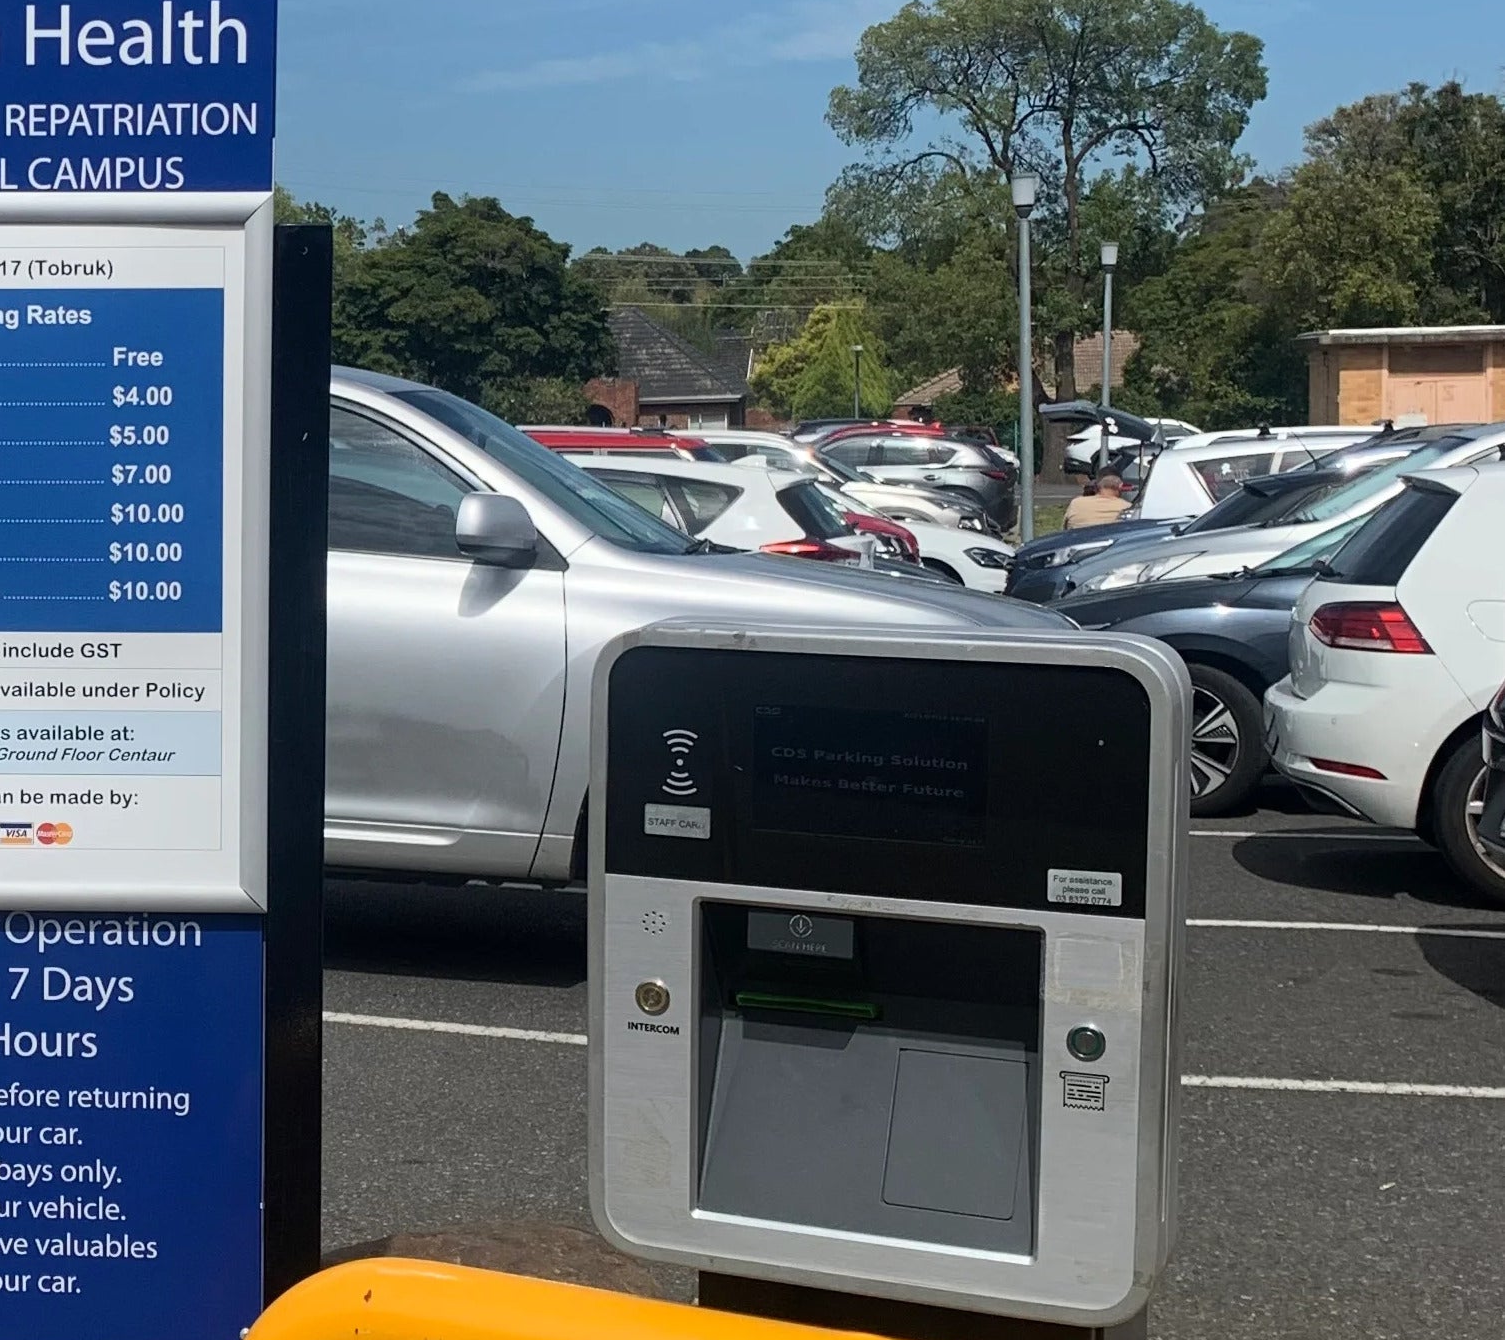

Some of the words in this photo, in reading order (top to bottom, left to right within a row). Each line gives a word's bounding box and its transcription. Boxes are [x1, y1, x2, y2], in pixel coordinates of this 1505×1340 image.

[26, 0, 246, 65] Health
[6, 103, 256, 136] REPATRIATION
[28, 157, 184, 189] CAMPUS
[29, 260, 112, 279] (Tobruk)
[28, 305, 91, 324] Rates
[114, 347, 163, 366] Free
[113, 386, 172, 407] $4.00
[110, 425, 169, 447] $5.00
[112, 464, 171, 485] $7.00
[111, 503, 183, 524] $10.00
[110, 542, 182, 563] $10.00
[109, 581, 181, 602] $10.00
[4, 643, 74, 658] include
[81, 643, 122, 658] GST
[83, 683, 139, 697] under
[147, 683, 205, 702] Policy
[17, 725, 104, 740] available
[111, 726, 134, 740] at:
[61, 748, 105, 760] Floor
[109, 748, 175, 761] Centaur
[21, 789, 43, 804] be
[51, 790, 103, 804] made
[111, 790, 137, 808] by:
[648, 818, 676, 826] STAFF
[6, 829, 27, 838] VISA
[5, 911, 201, 952] Operation
[9, 968, 29, 999] 7
[44, 967, 133, 1011] Days
[627, 1021, 680, 1035] INTERCOM
[69, 1087, 189, 1116] returning
[40, 1127, 82, 1145] car.
[61, 1159, 121, 1189] only.
[29, 1195, 125, 1220] vehicle.
[35, 1233, 157, 1258] valuables
[38, 1276, 80, 1293] car.
